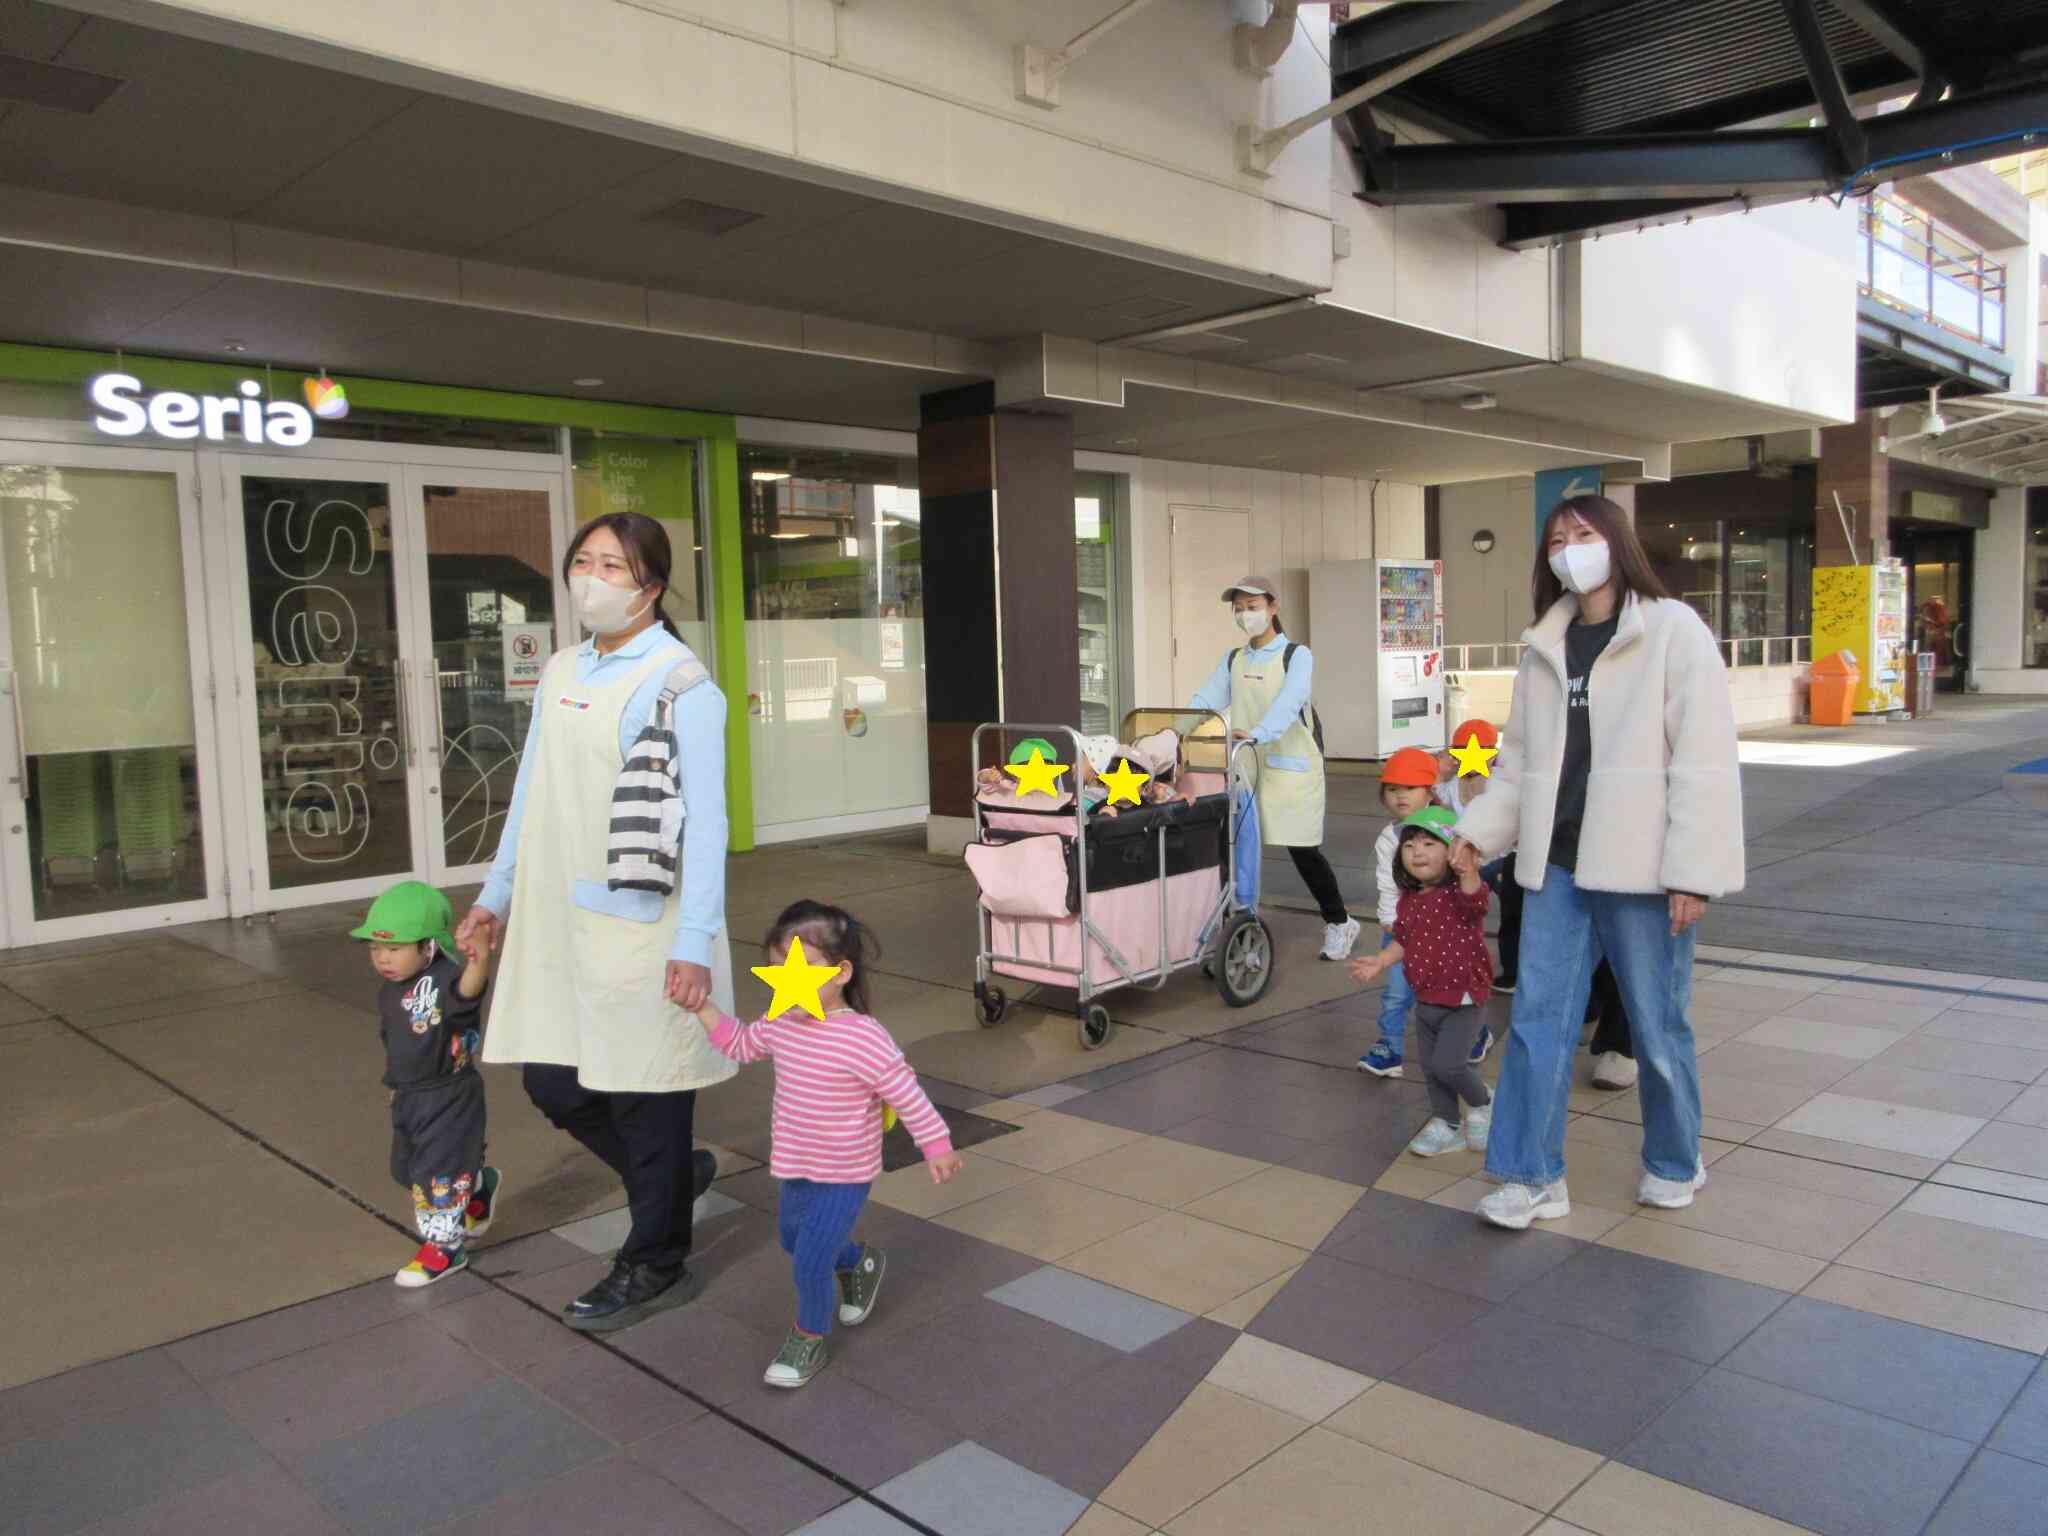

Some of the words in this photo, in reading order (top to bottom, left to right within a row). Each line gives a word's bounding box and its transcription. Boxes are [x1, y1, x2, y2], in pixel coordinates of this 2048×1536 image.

[91, 373, 314, 446] Seria
[607, 451, 648, 468] Color
[610, 472, 634, 487] the
[264, 500, 398, 862] Seria
